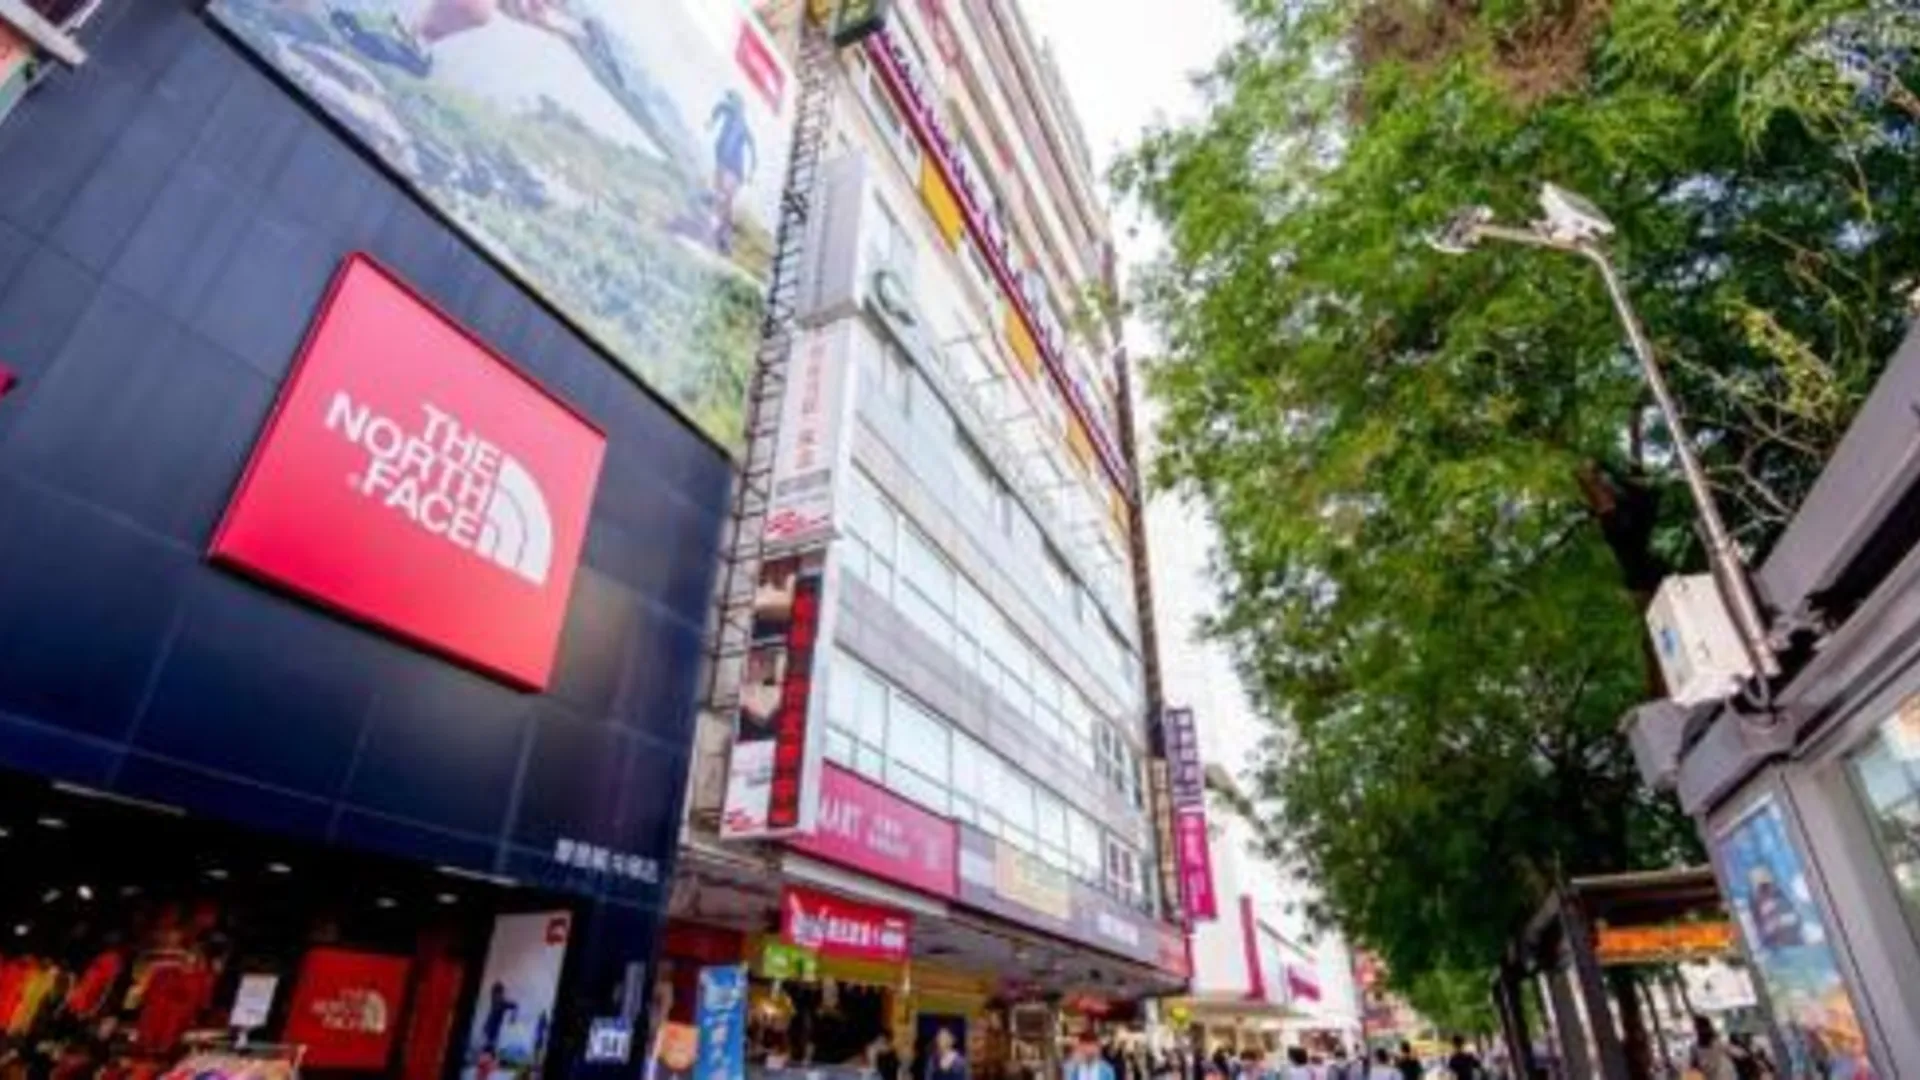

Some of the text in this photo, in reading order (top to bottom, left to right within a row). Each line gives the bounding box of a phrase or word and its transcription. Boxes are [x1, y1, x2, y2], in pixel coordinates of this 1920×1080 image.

[325, 390, 493, 524] NORTH
[420, 403, 500, 480] THE
[361, 457, 480, 550] FACE
